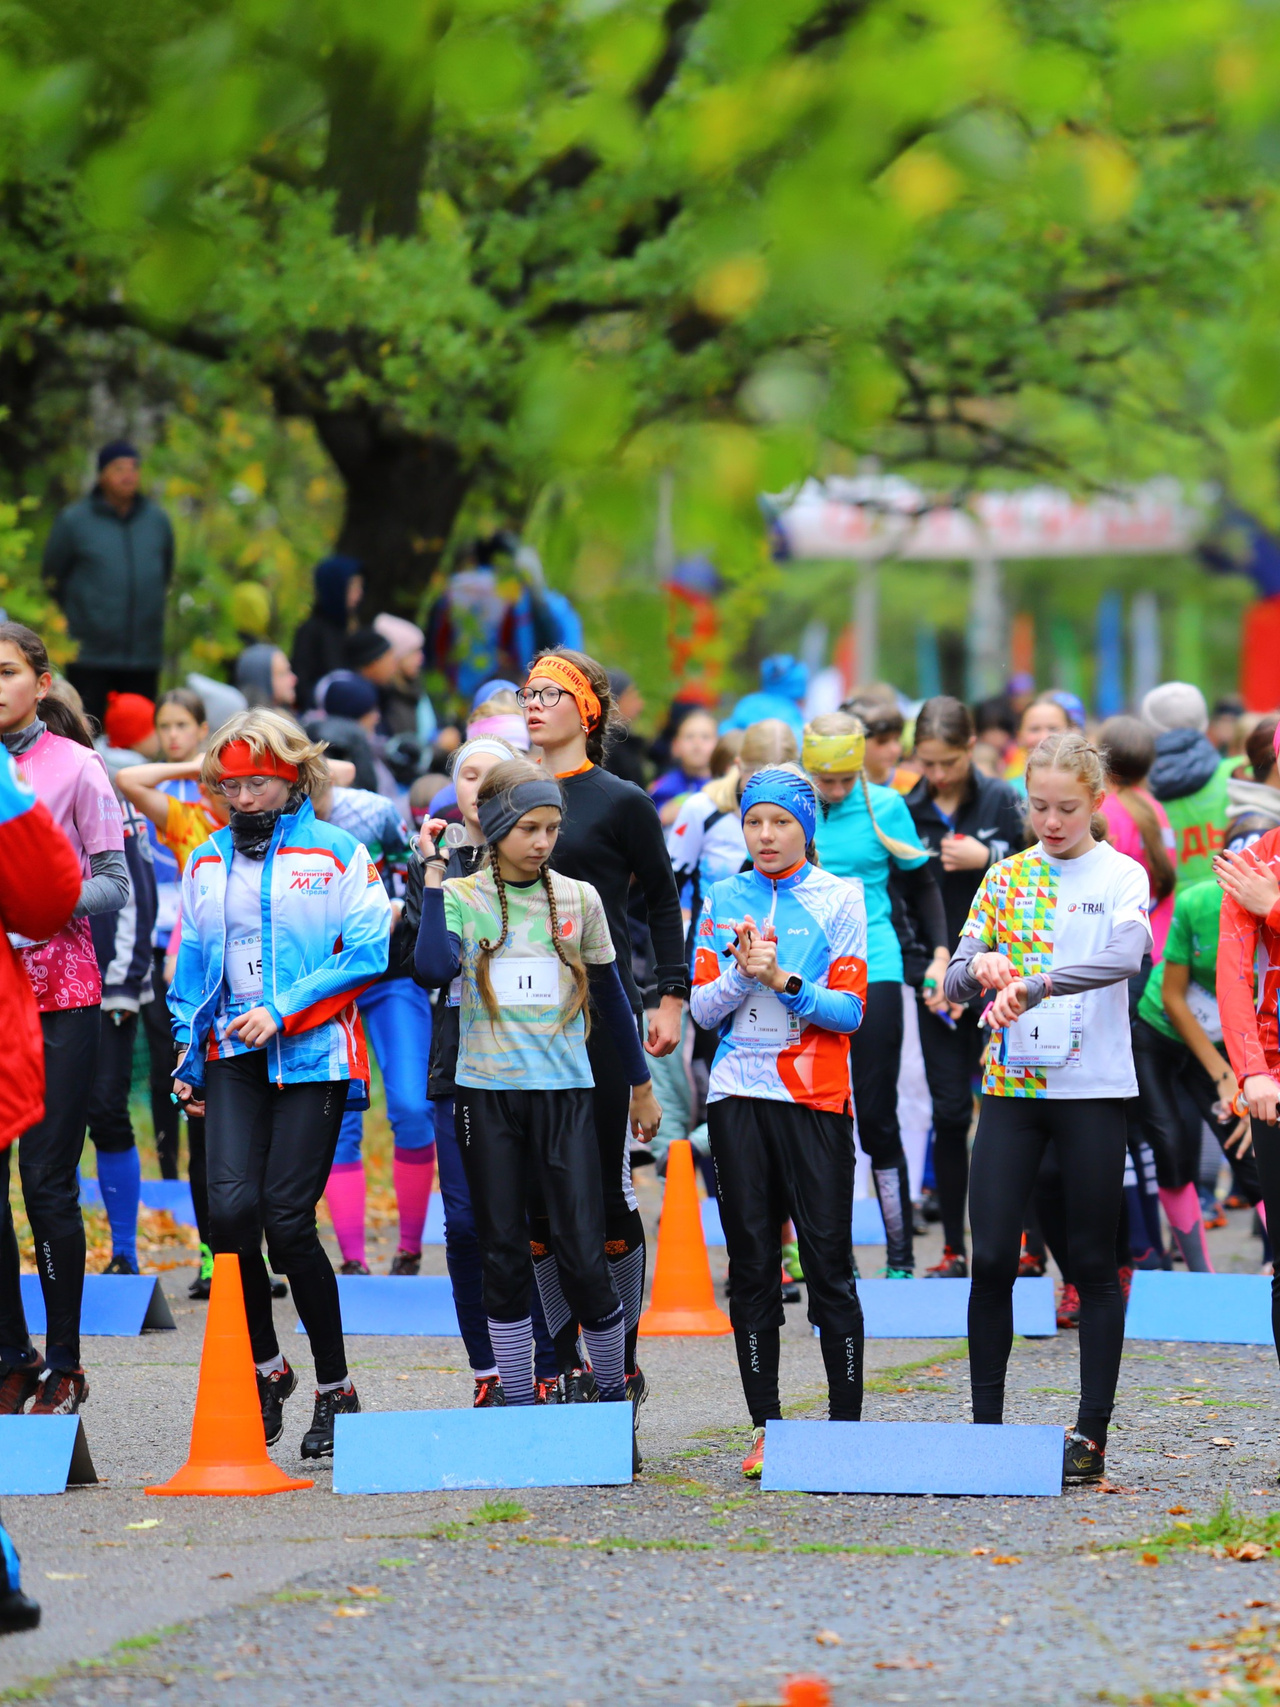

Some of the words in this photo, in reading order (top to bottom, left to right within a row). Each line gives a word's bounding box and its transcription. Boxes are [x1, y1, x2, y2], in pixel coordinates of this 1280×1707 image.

[517, 974, 533, 990] 11
[748, 1008, 757, 1023] 5
[1029, 1026, 1039, 1040] 4
